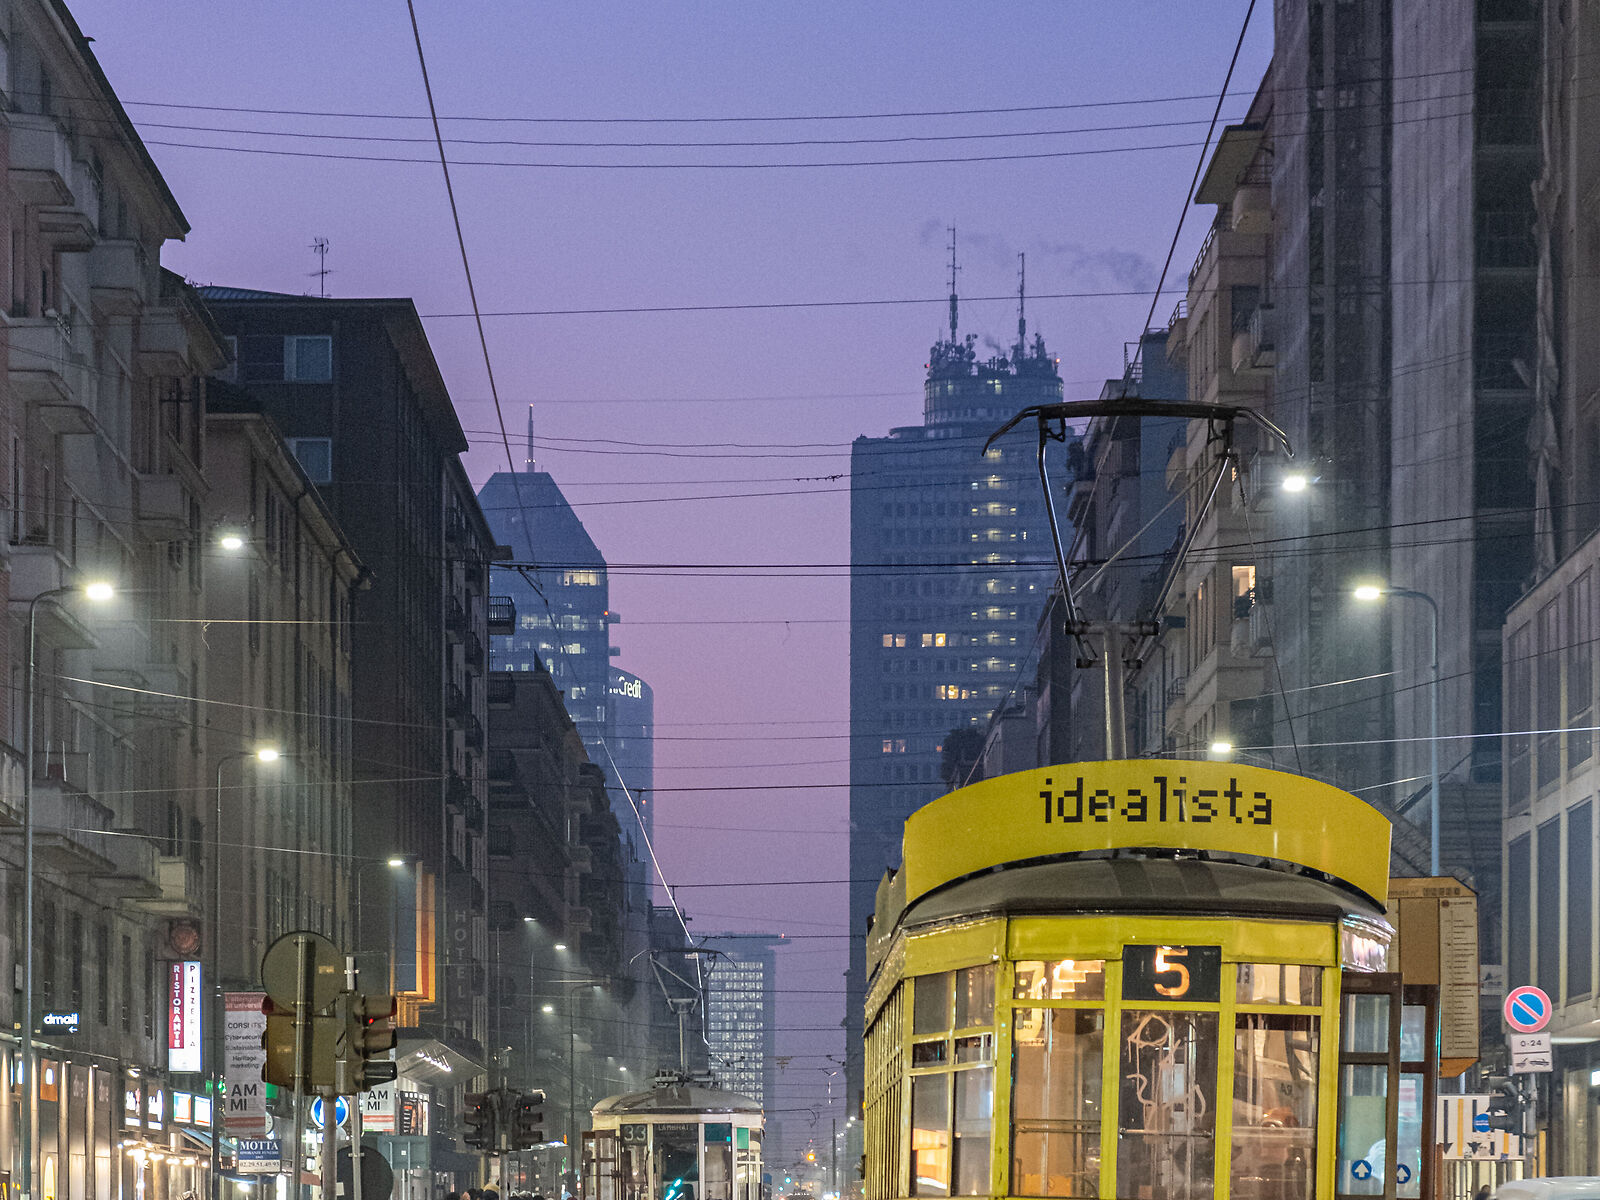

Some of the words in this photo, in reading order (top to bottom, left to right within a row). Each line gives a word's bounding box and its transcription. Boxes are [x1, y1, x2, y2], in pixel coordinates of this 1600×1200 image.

[1039, 776, 1272, 825] idealista
[454, 910, 467, 999] HOTEL
[1154, 947, 1190, 998] 5
[173, 964, 182, 1048] RISTORANTE
[43, 1013, 79, 1025] dmail
[1520, 1039, 1542, 1047] 0-24
[231, 1083, 257, 1097] AM
[368, 1090, 388, 1100] AM
[230, 1098, 248, 1111] MI
[367, 1101, 380, 1111] MI
[624, 1125, 646, 1142] 33
[240, 1141, 279, 1150] MOTTA
